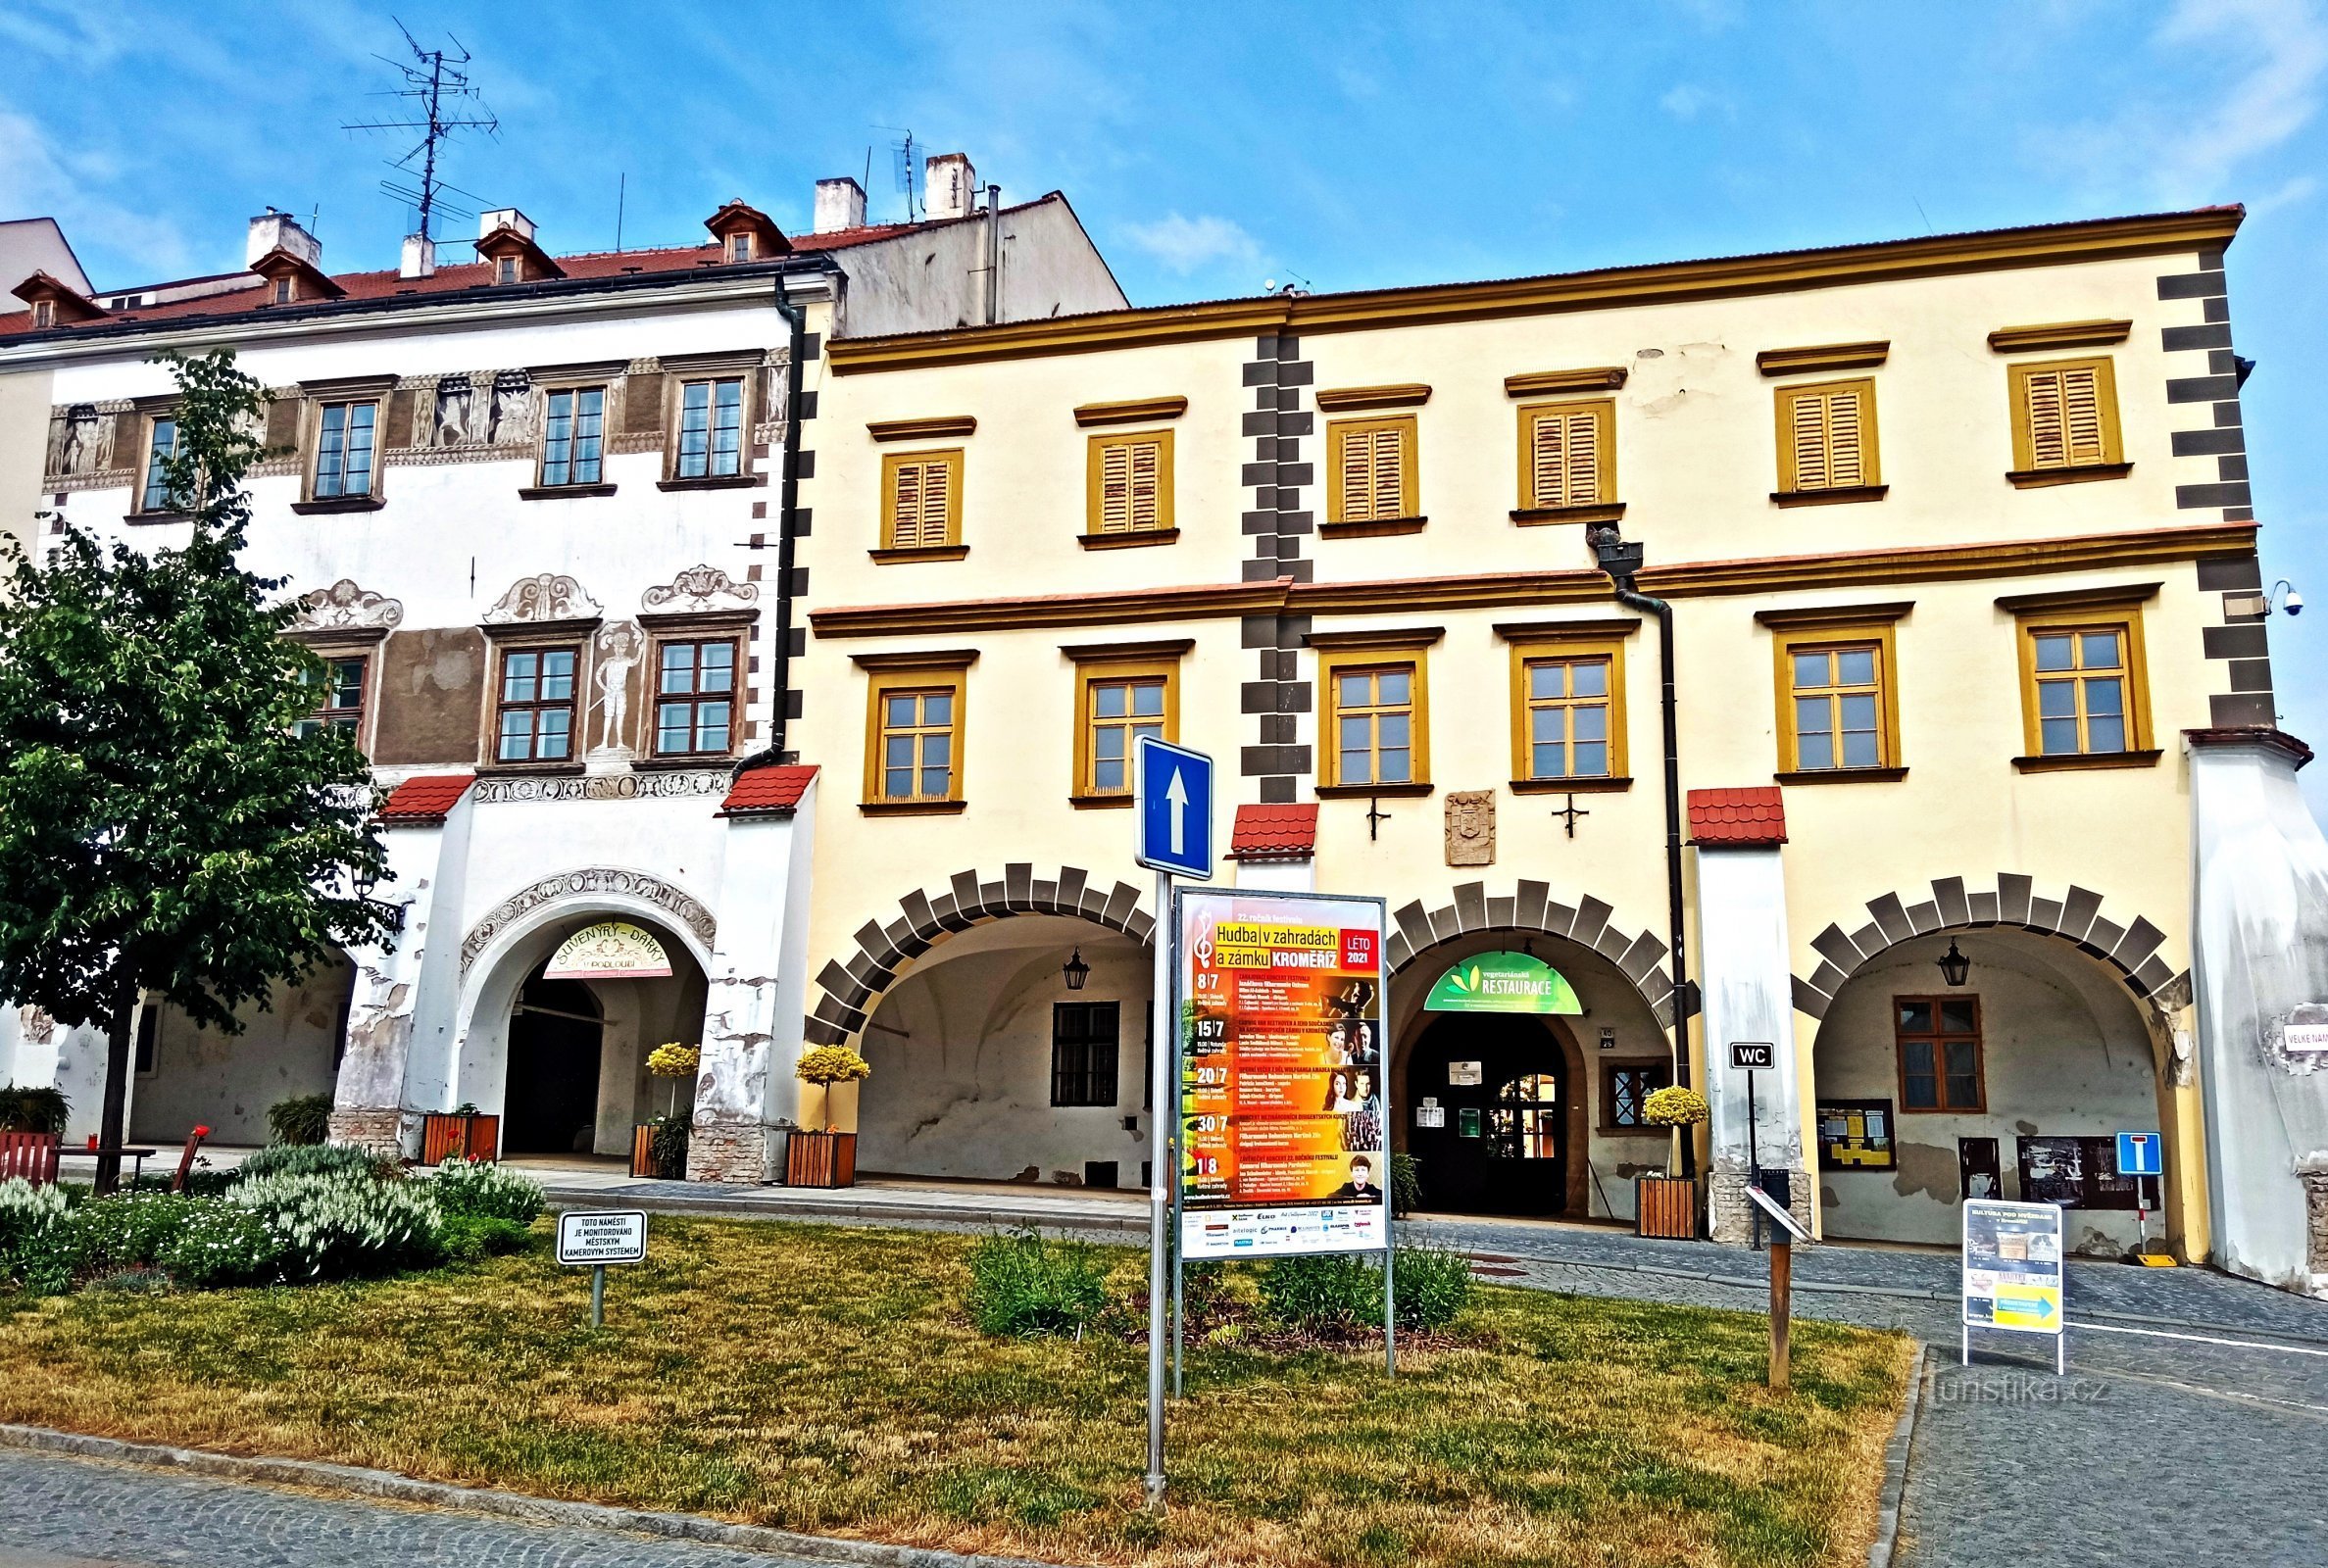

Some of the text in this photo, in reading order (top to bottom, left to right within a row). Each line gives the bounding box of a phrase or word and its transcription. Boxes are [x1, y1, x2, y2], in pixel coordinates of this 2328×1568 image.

[1250, 913, 1273, 923] ročník
[1217, 926, 1336, 946] Hudba v zahradách
[1347, 937, 1370, 951] LÉTO
[1217, 949, 1337, 968] a zámku KROMĚŘÍŽ
[1347, 953, 1368, 963] 2021
[1482, 970, 1530, 979] vegetariánská
[1482, 980, 1552, 996] RESTAURACE
[1739, 1049, 1765, 1063] WC
[581, 1216, 626, 1227] TOTO NÁMĚSTÍ
[583, 1227, 632, 1237] MONITOROVÁNO
[585, 1237, 619, 1246] MĚSTSKÝM
[565, 1246, 639, 1256] KAMEROVÝM SYSTÉMEM
